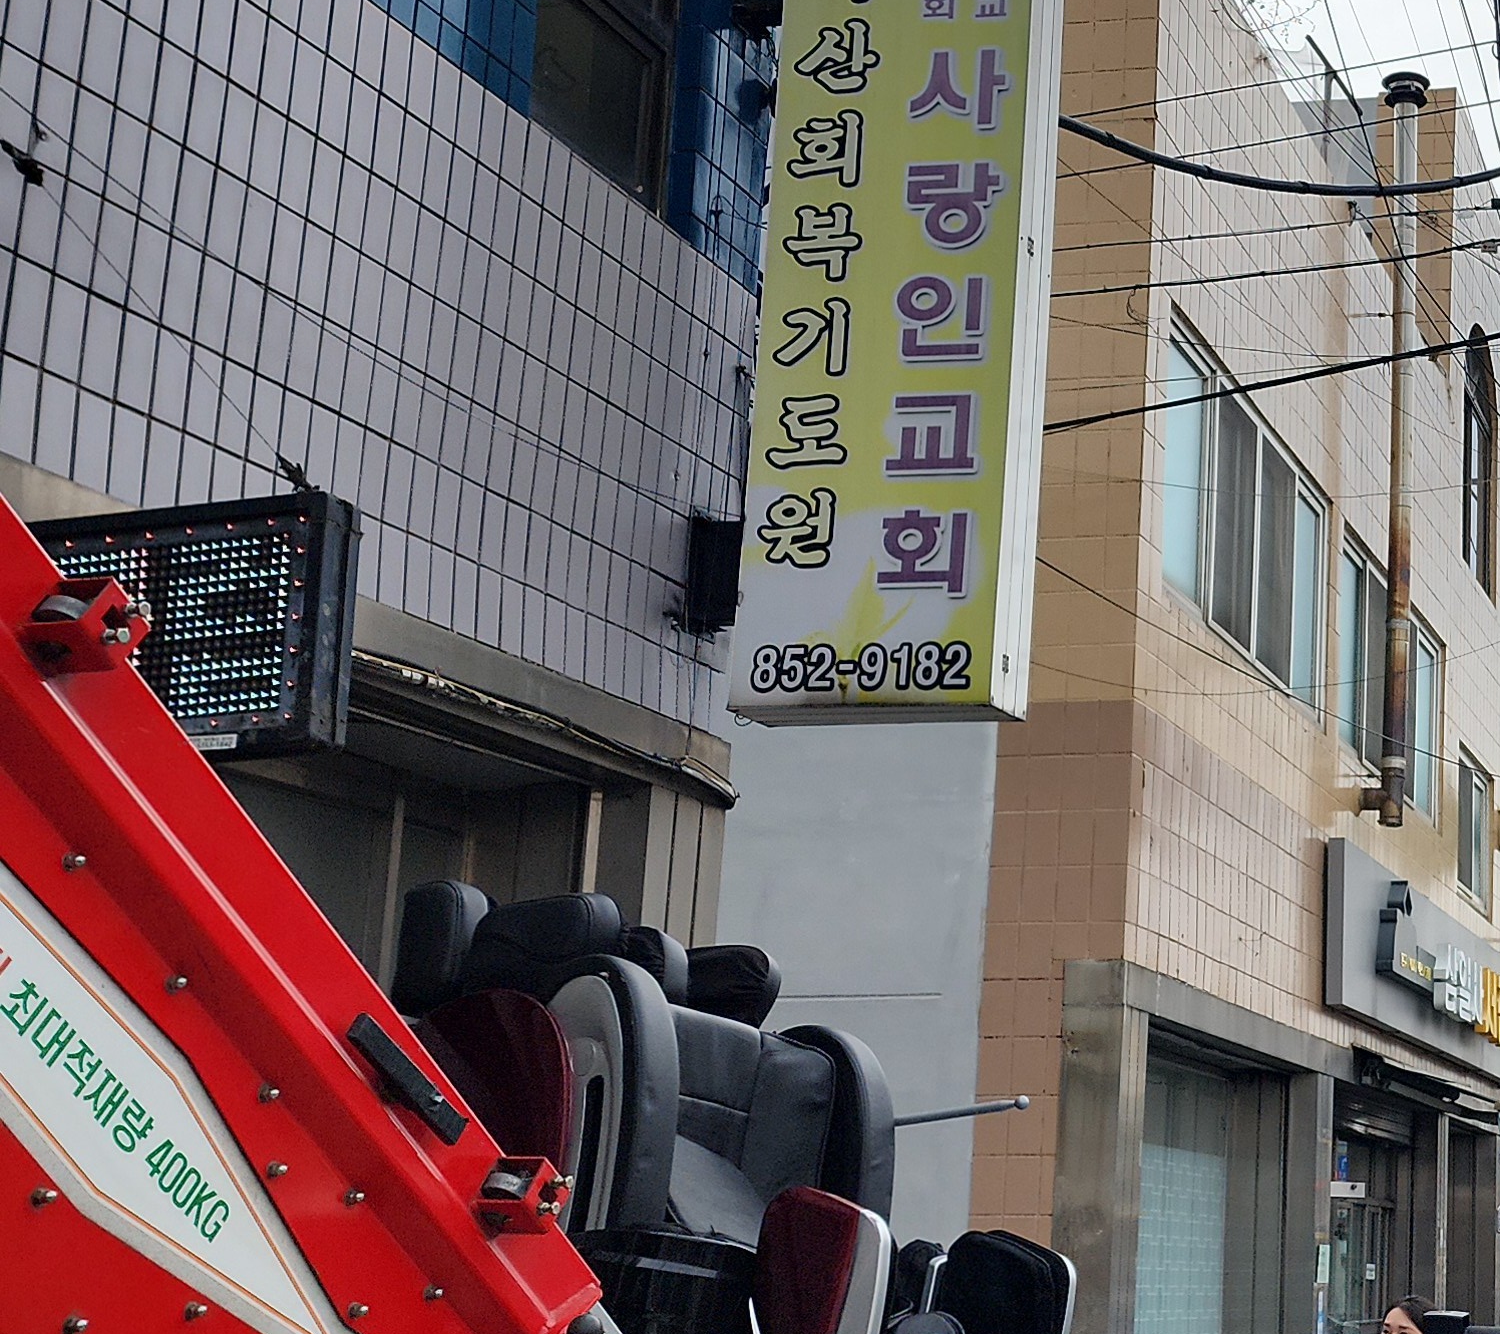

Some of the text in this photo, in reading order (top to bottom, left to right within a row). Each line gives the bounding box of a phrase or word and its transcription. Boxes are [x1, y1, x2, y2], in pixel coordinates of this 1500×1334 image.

[876, 48, 1011, 598] 사랑인교회
[750, 640, 972, 694] 852-9182
[0, 978, 231, 1244] 최대적재량 400KG
